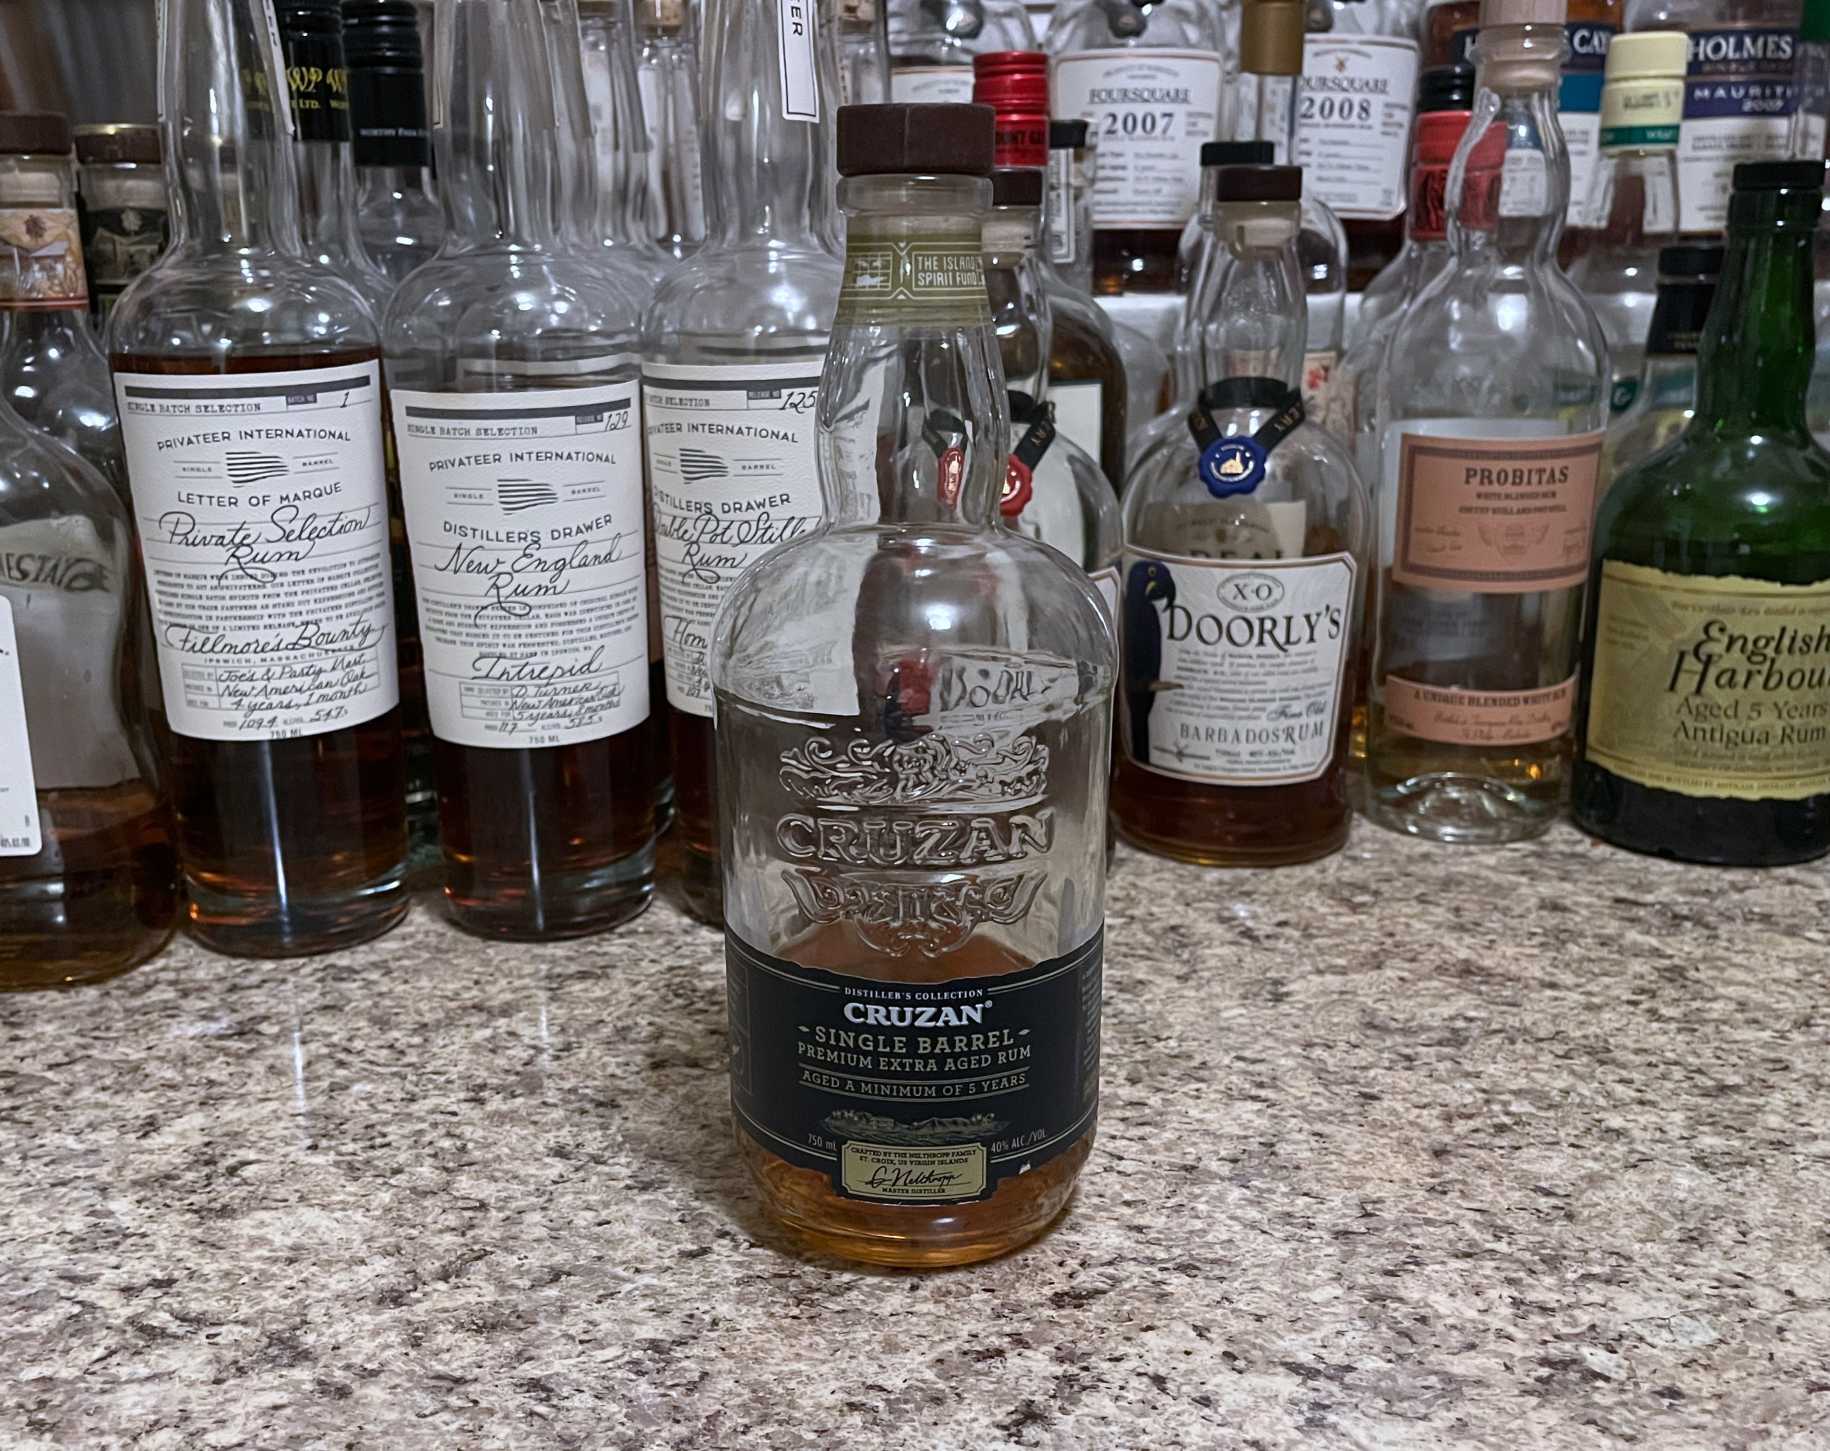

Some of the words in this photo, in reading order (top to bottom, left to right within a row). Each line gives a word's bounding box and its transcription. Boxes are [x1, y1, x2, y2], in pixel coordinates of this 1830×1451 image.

[790, 0, 803, 37] ER
[1688, 35, 1793, 62] HOLMES
[1088, 87, 1191, 104] FOURSQUARE
[1300, 76, 1389, 94] OURSQUARE
[1301, 96, 1371, 121] 2008
[1104, 112, 1175, 136] 2007
[917, 256, 939, 270] THE
[917, 272, 953, 286] SPIRIT
[159, 402, 191, 413] BATCH
[195, 402, 262, 413] SELECTION
[779, 390, 819, 414] 125
[439, 425, 471, 437] BATCH
[475, 426, 538, 437] SELECTION
[604, 410, 629, 431] 129
[688, 422, 799, 443] INTERNATIONAL
[157, 431, 231, 451] PRIVATEER
[239, 428, 351, 442] INTERNATIONAL
[429, 453, 502, 472] PRIVATEER
[510, 451, 616, 465] INTERNATIONAL
[1463, 466, 1569, 486] PROBITAS
[177, 491, 238, 507] LETTER
[248, 495, 270, 507] OF
[280, 482, 342, 504] MARQUE
[721, 493, 792, 514] DRAWER
[158, 510, 263, 547] Private
[264, 504, 371, 545] Selection
[550, 513, 613, 541] DRAWER
[693, 513, 735, 545] Pot
[219, 540, 315, 587] Rum
[434, 542, 506, 575] New
[511, 532, 624, 584] England
[681, 541, 748, 584] Rum
[474, 571, 570, 628] Rum
[165, 623, 285, 655] Fillmore's
[287, 617, 386, 651] Bounty
[1164, 604, 1342, 653] DOORLY'S
[1693, 618, 1830, 665] English
[471, 645, 605, 686] Intrepid
[1664, 650, 1830, 697] Harbou
[1467, 694, 1521, 707] BLENDED
[1676, 697, 1739, 723] Aged
[1747, 702, 1762, 721] 5
[1773, 700, 1828, 720] Years
[1180, 722, 1280, 745] BARBADOS
[1282, 720, 1325, 745] RUM
[1673, 720, 1770, 750] Antigua
[1780, 724, 1827, 746] Rum
[777, 807, 1056, 866] CRUZAN
[844, 987, 911, 1000] DISTILLER'S
[915, 988, 984, 1001] COLLECTION
[815, 1026, 907, 1053] SINGLE
[918, 1029, 1015, 1054] BARREL
[798, 1041, 873, 1069] PREMIUM
[879, 1058, 938, 1072] EXTRA
[944, 1055, 992, 1071] AGED
[998, 1045, 1032, 1064] RUM
[802, 1070, 840, 1088] AGED
[845, 1077, 856, 1091] A
[860, 1082, 937, 1097] MINIMUM
[942, 1085, 964, 1096] OF
[968, 1083, 976, 1094] 5
[981, 1073, 1027, 1093] YEARS
[808, 1133, 823, 1147] 750
